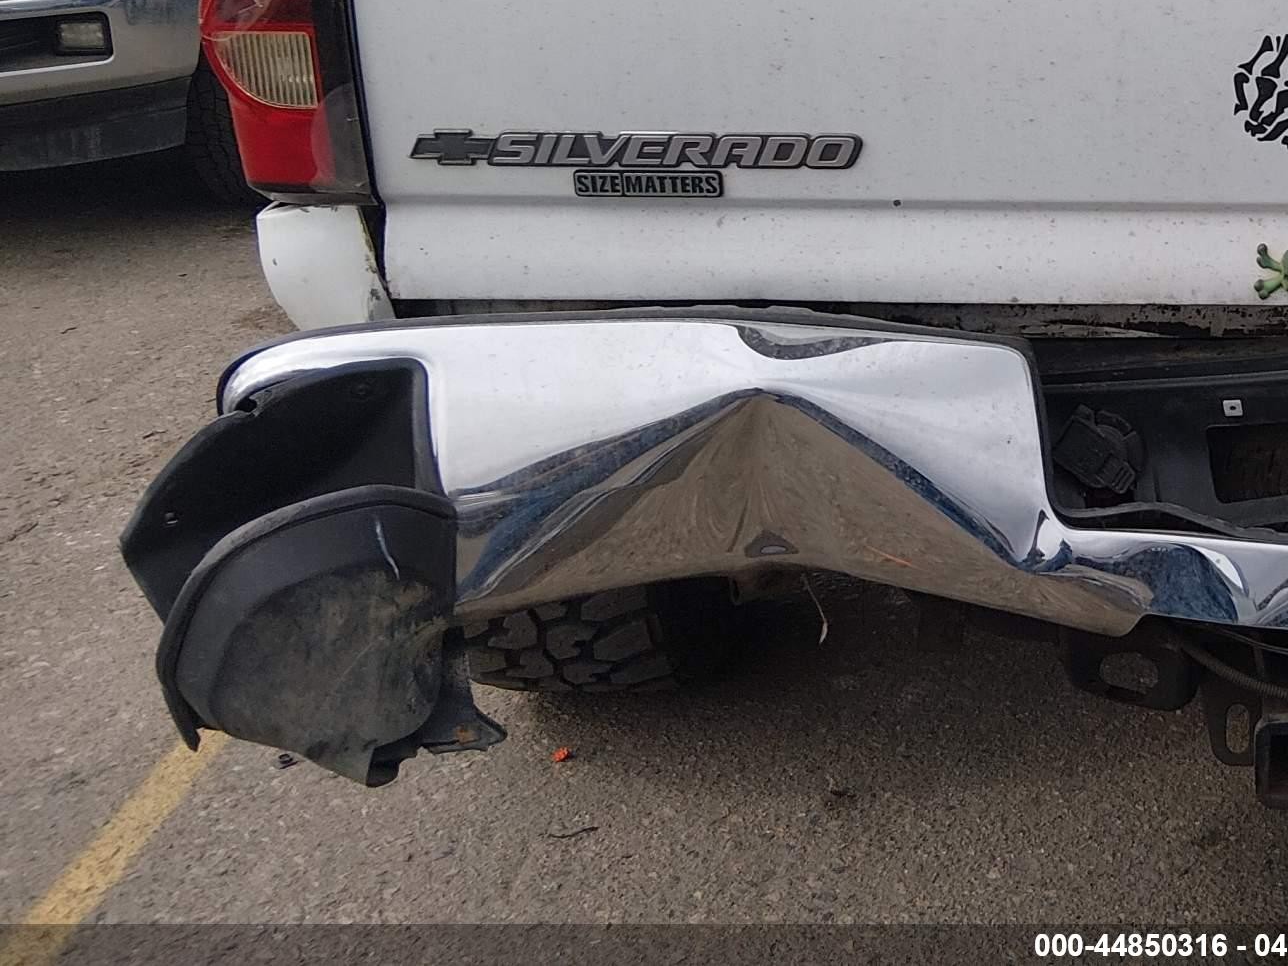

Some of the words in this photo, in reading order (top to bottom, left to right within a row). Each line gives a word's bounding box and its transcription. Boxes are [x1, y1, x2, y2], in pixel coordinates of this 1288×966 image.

[488, 130, 862, 169] SILVERADO
[575, 172, 621, 195] SIZE
[624, 172, 720, 195] MATTERS
